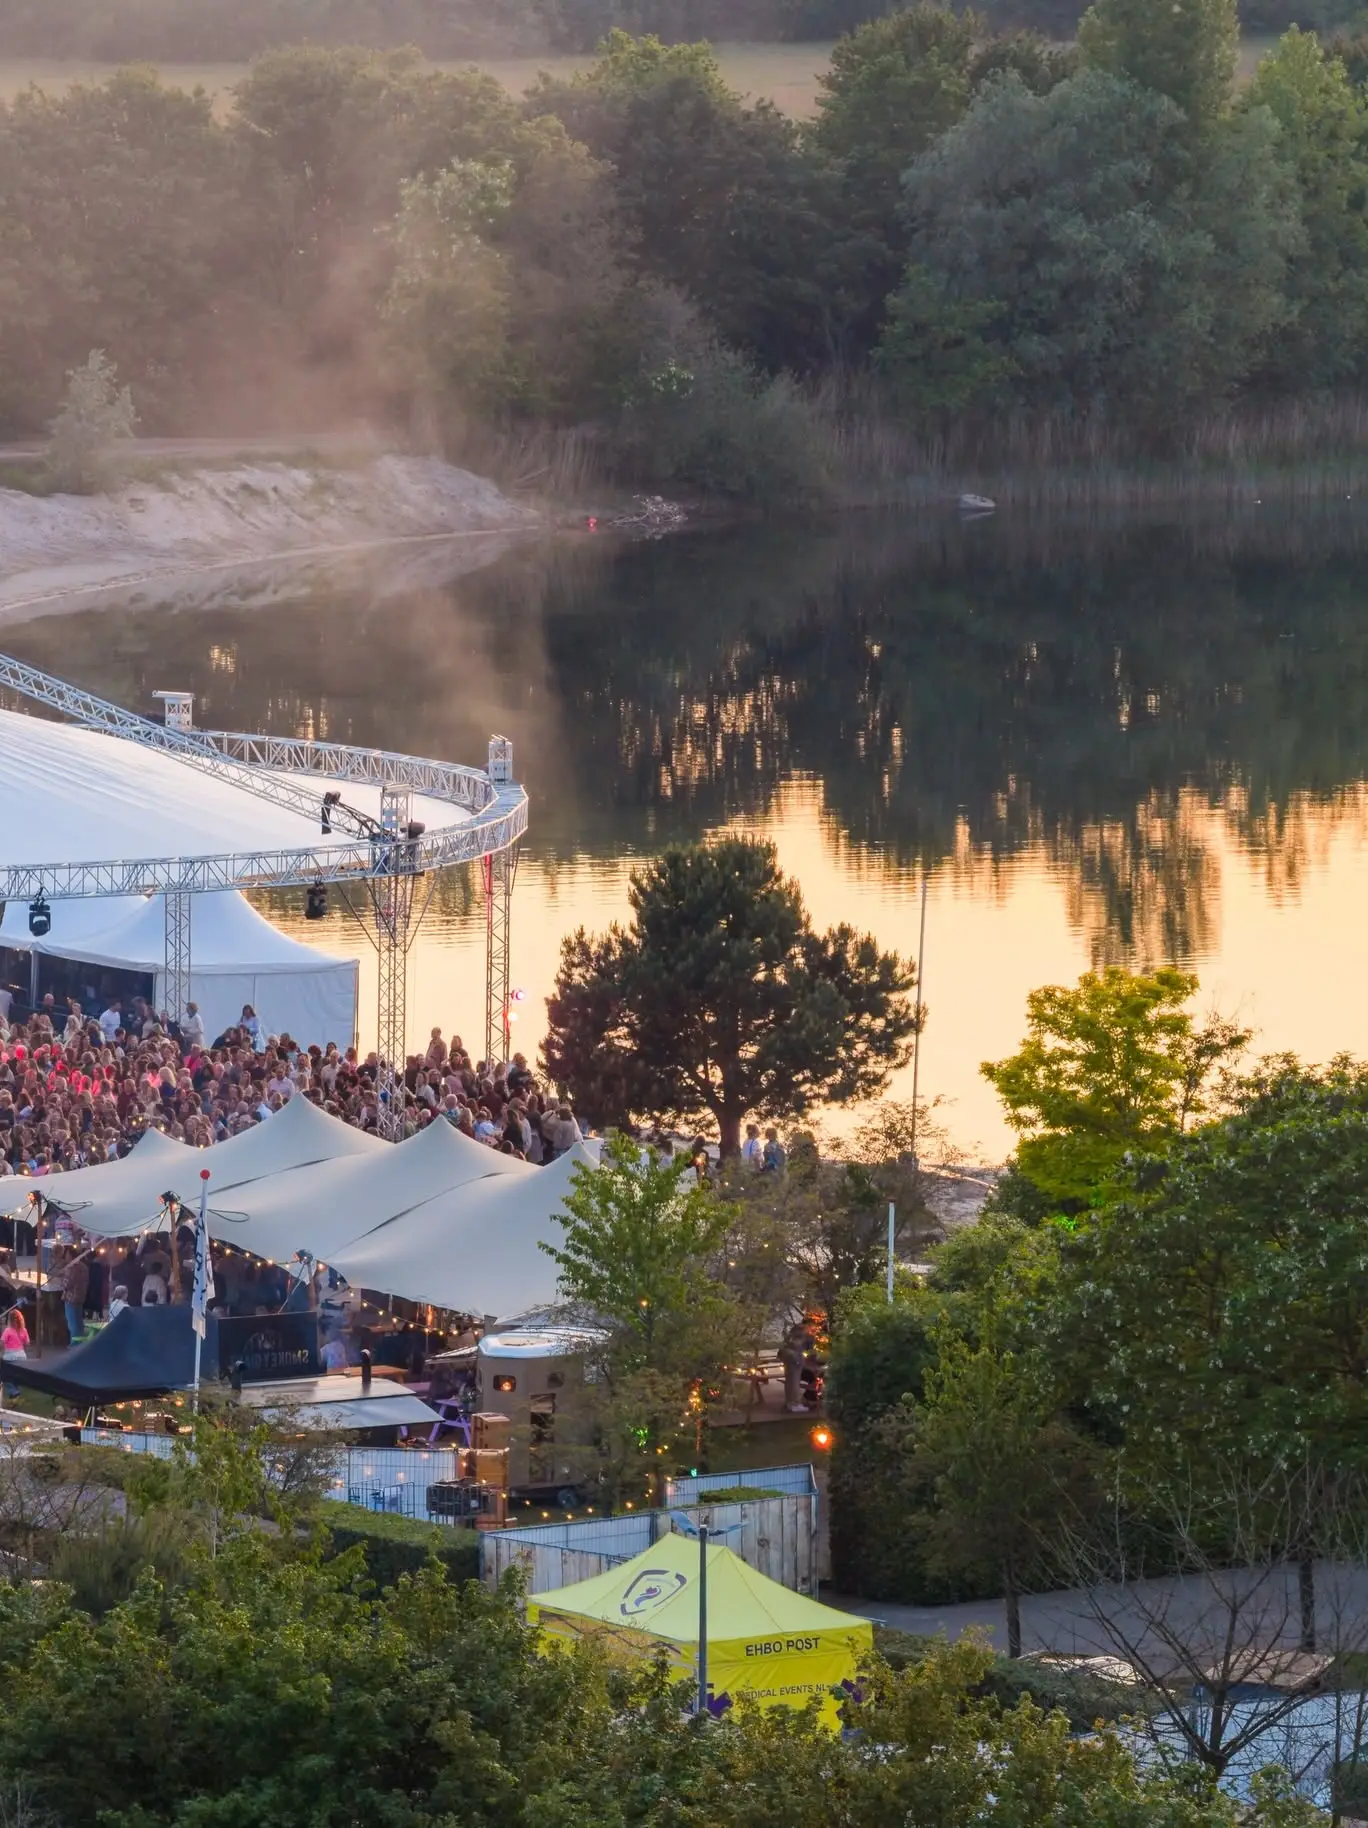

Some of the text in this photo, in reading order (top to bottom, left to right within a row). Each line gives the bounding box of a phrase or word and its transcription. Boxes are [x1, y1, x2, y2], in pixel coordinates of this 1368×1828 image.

[745, 1637, 821, 1656] EHBO POST
[779, 1684, 814, 1696] EVENTS
